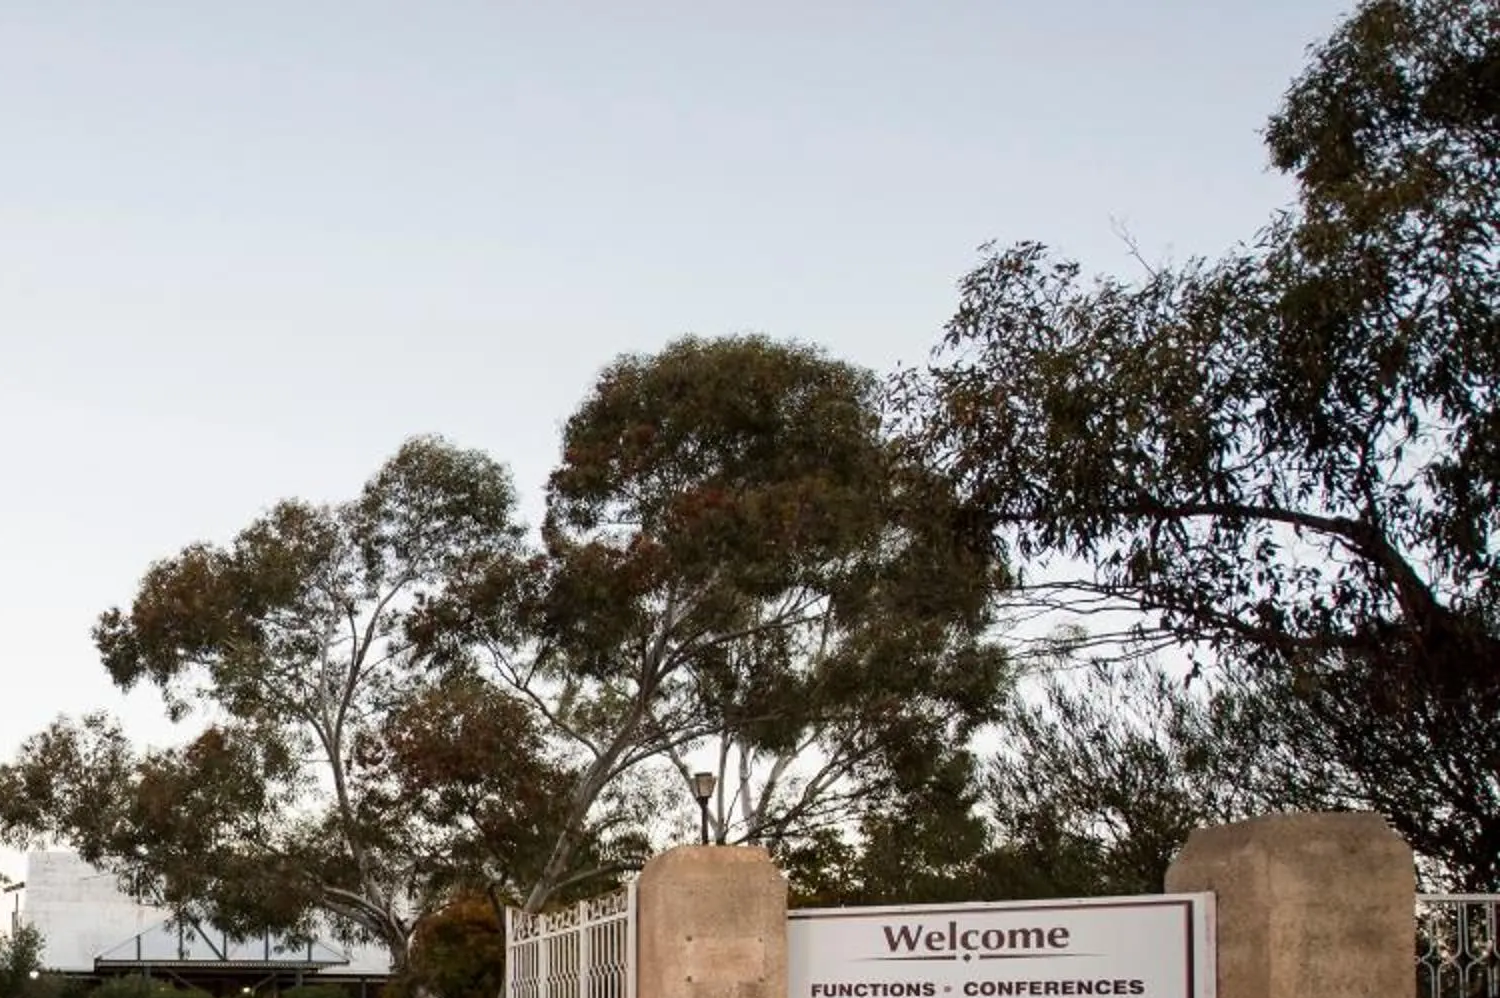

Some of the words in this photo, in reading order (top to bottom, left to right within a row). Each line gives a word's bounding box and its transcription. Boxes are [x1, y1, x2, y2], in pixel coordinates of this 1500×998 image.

[883, 921, 1071, 953] Welcome
[811, 982, 936, 998] FUNCTIONS
[963, 979, 1146, 997] CONFERENCES
